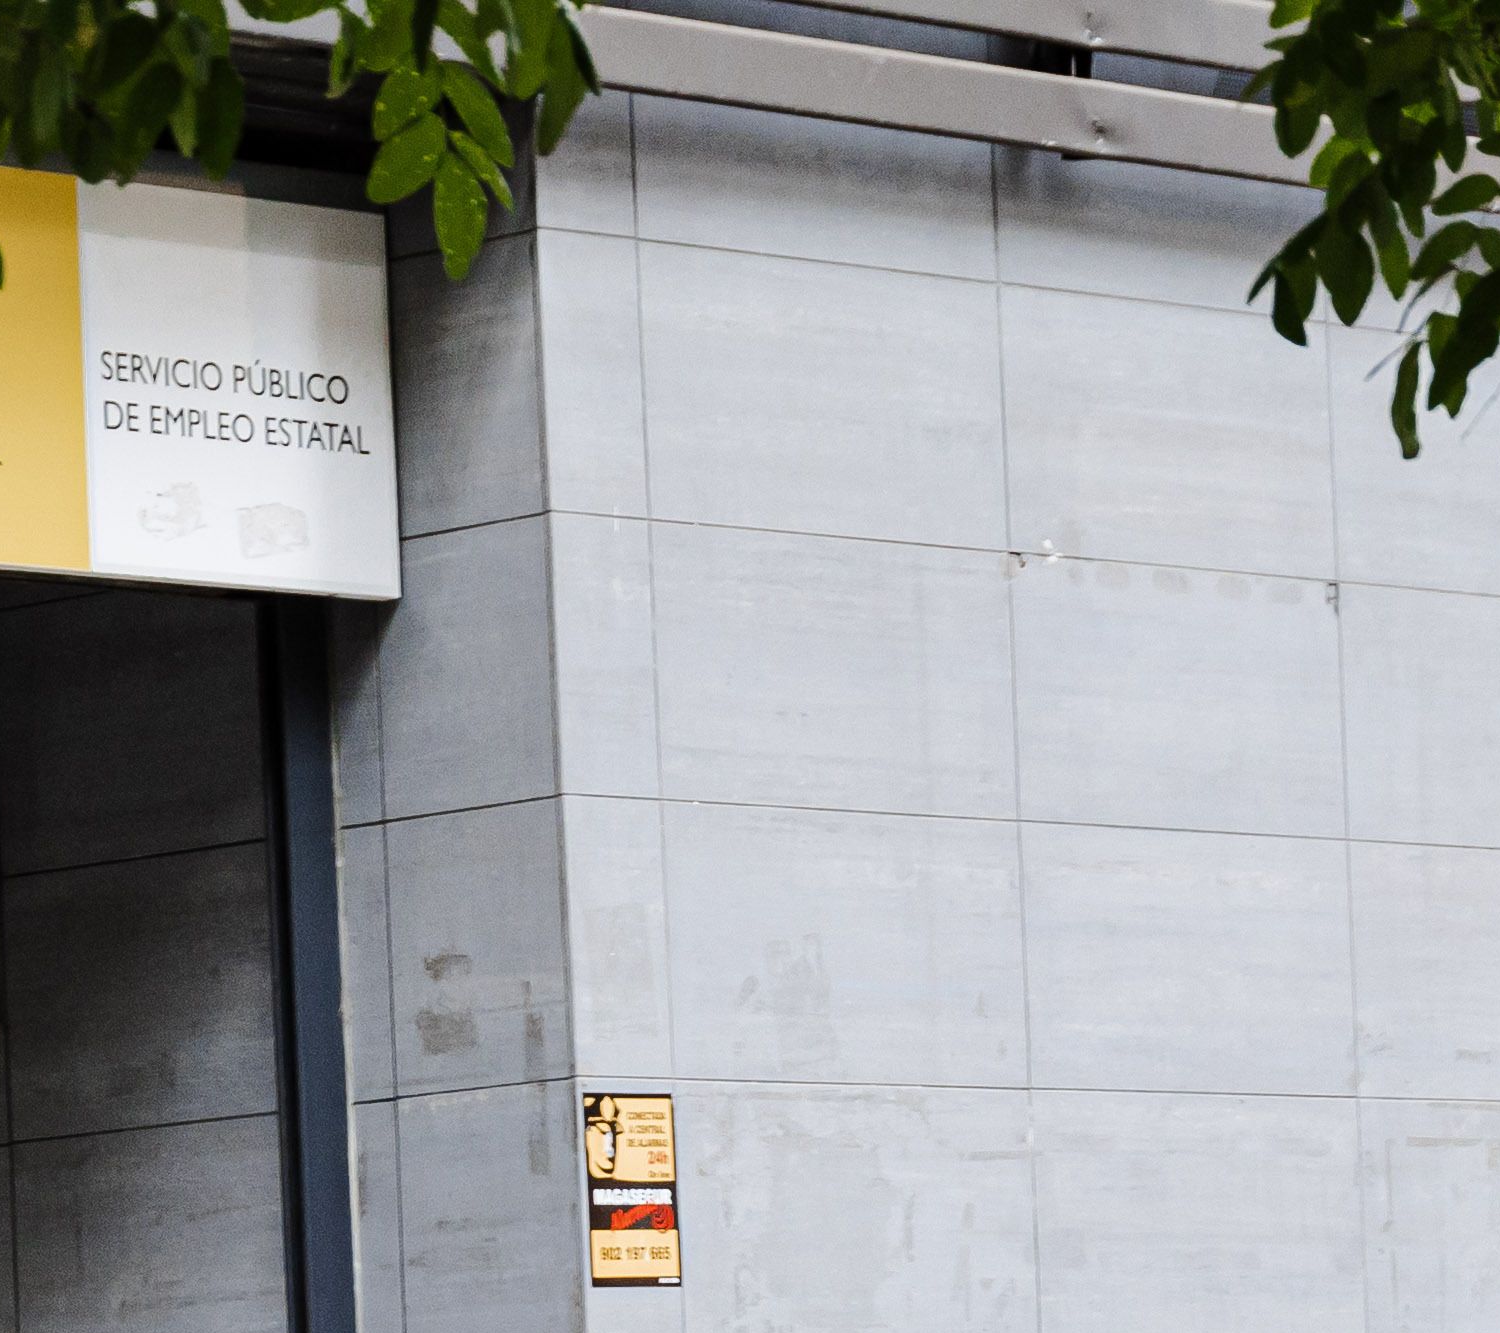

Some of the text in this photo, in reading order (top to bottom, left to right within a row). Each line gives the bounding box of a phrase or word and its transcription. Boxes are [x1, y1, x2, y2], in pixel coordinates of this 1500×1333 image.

[100, 351, 349, 405] SERVICIO PÚBLICO
[103, 400, 371, 455] DE EMPLEO ESTATAL
